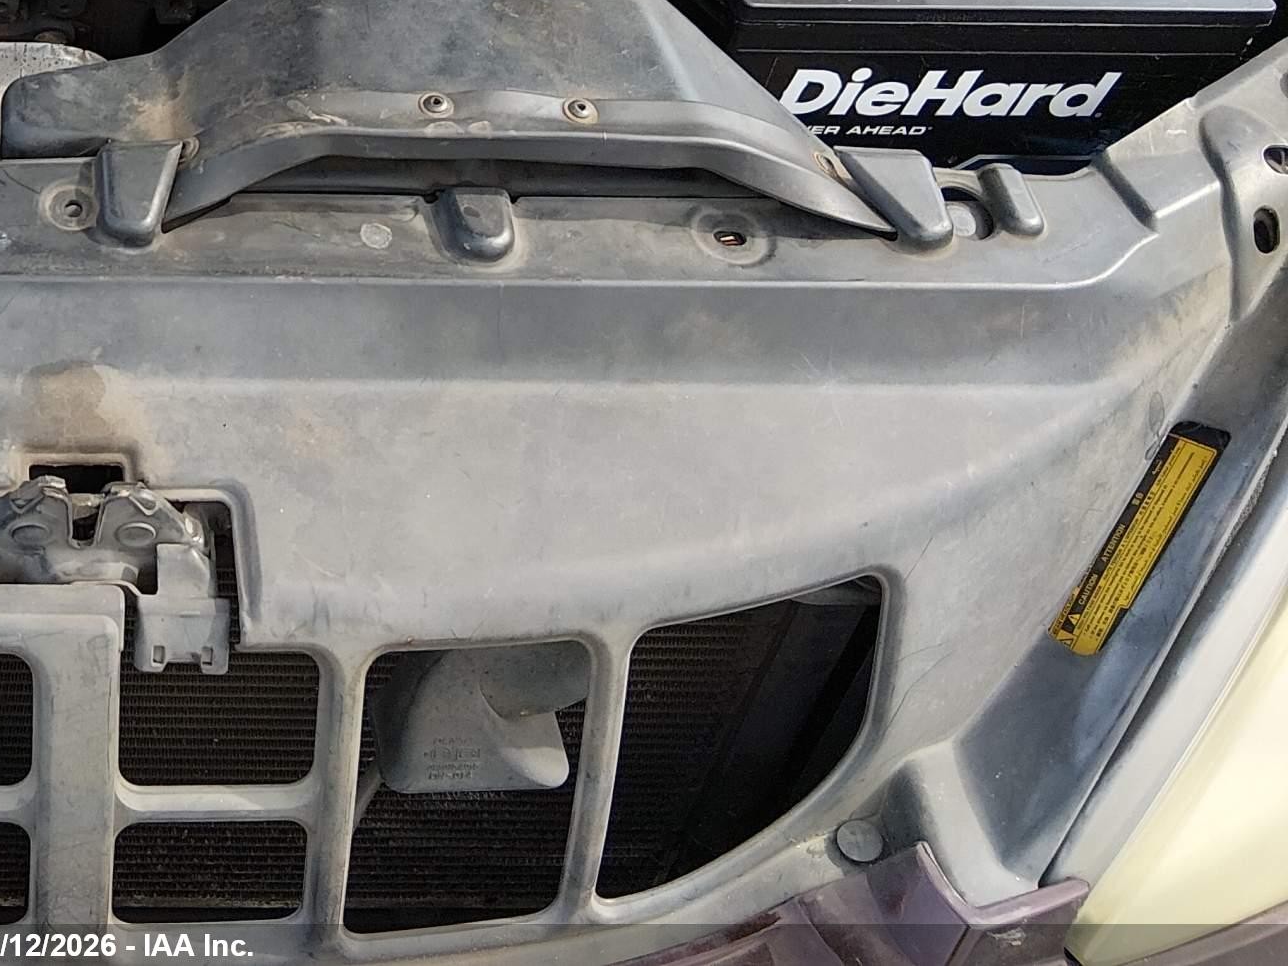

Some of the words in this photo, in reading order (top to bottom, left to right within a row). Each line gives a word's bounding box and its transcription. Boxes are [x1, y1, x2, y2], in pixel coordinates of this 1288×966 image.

[779, 67, 1123, 118] DieHard
[1078, 573, 1098, 605] CAUTION
[1101, 523, 1126, 563] ATTENTION
